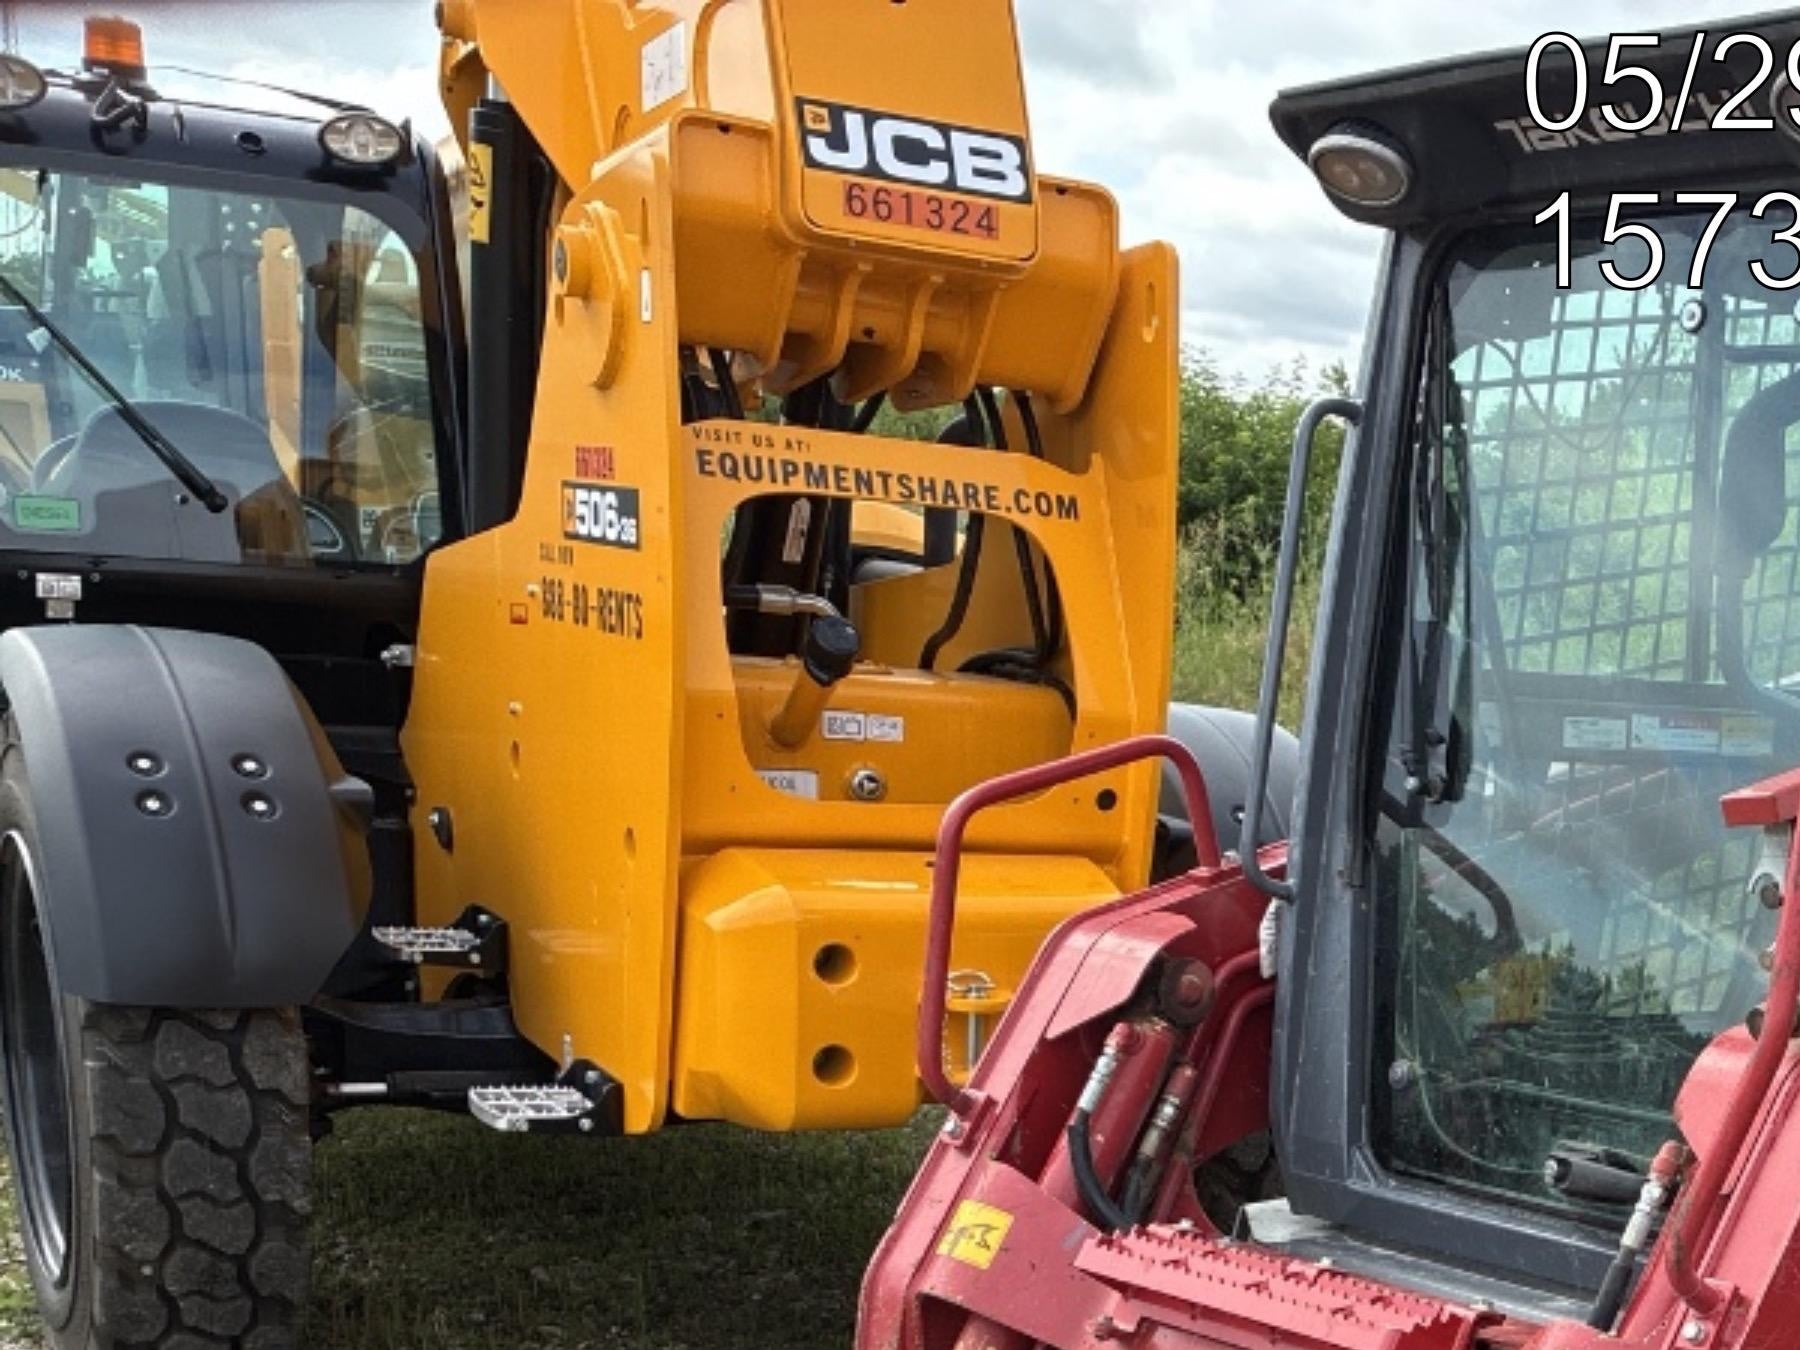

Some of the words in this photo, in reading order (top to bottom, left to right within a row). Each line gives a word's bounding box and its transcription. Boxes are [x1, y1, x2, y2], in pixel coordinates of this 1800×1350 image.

[806, 110, 1027, 197] JCB
[847, 182, 998, 237] 661324
[692, 426, 742, 444] VISIT
[752, 432, 775, 448] US
[695, 449, 1080, 520] EQUIPMENTSHARE.COM
